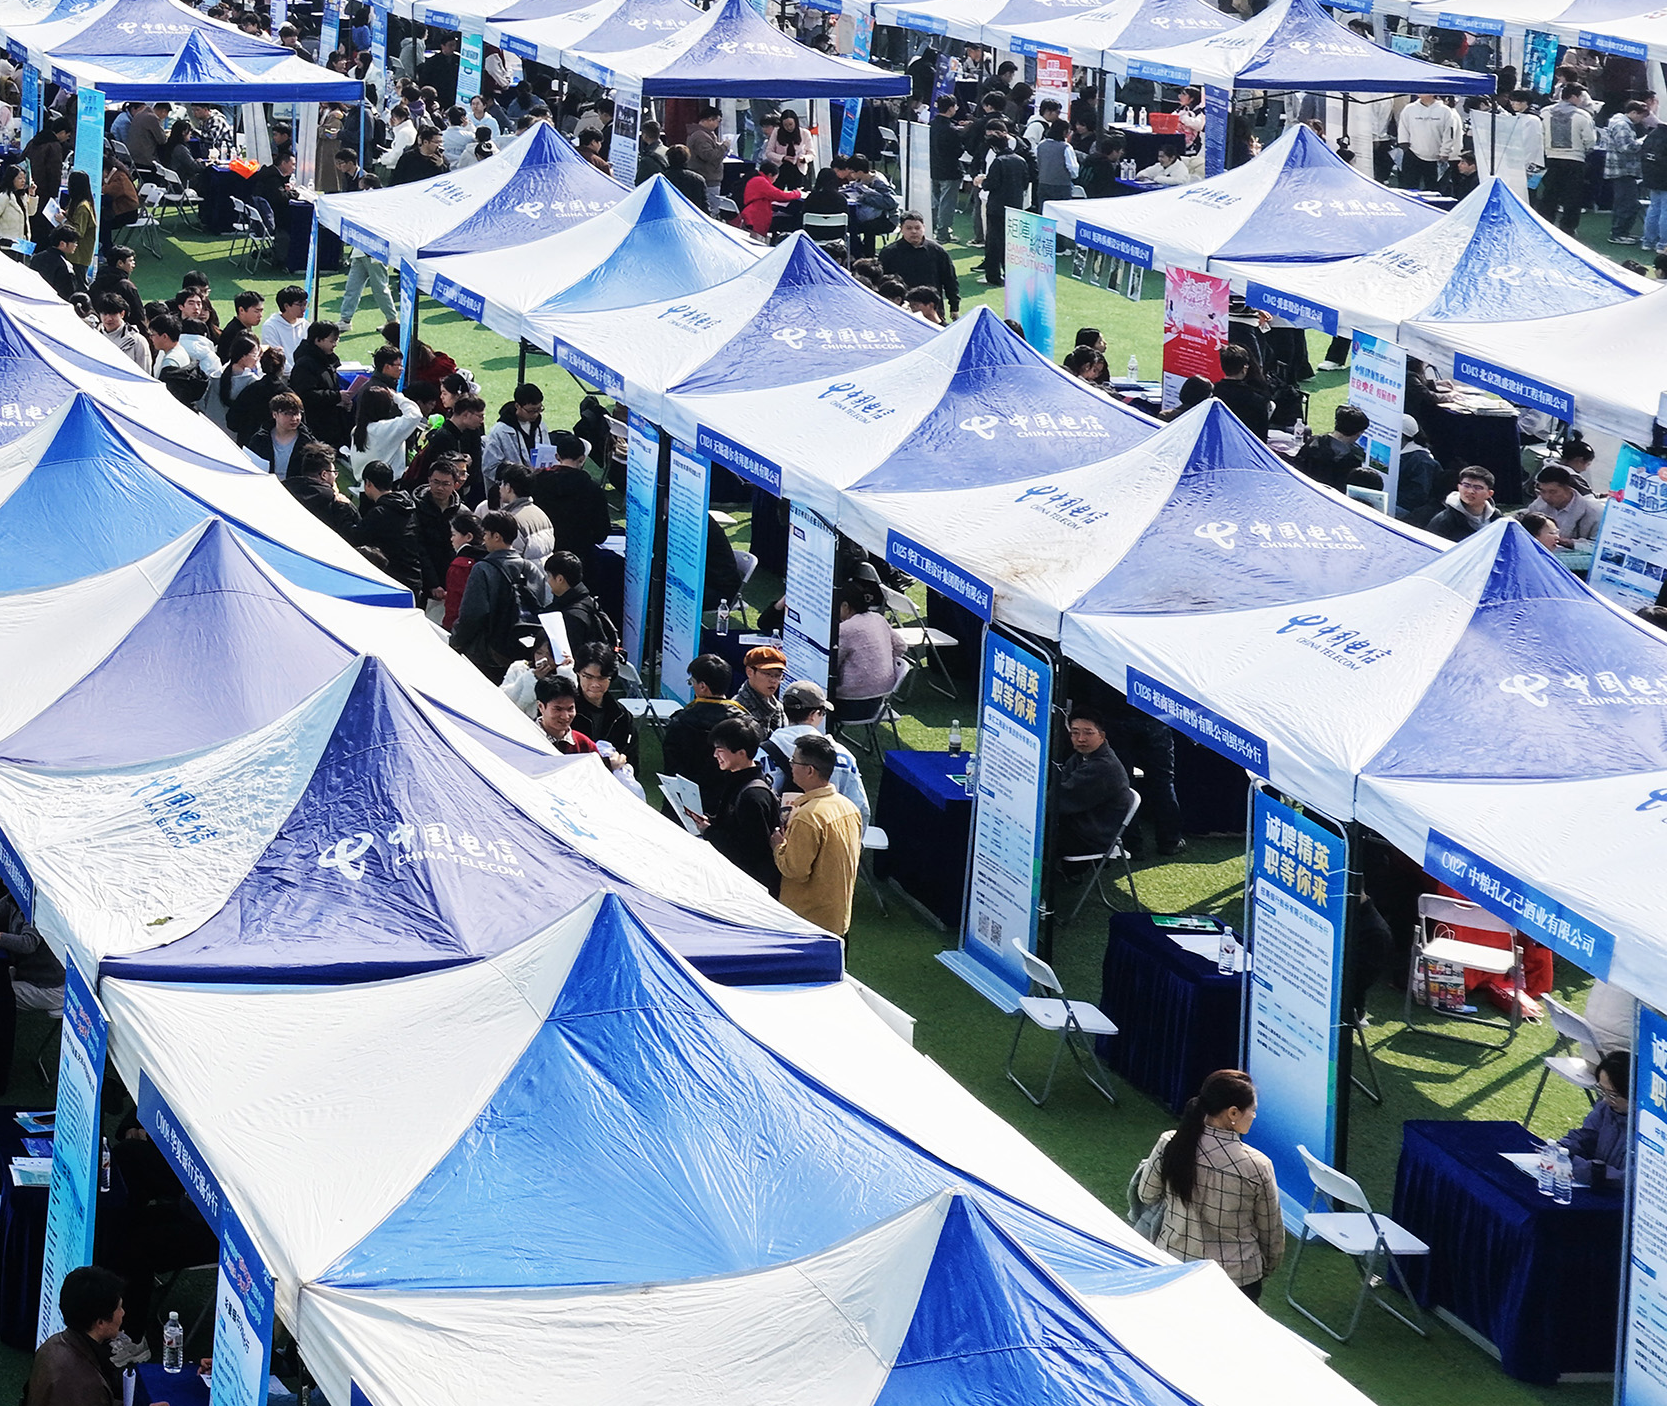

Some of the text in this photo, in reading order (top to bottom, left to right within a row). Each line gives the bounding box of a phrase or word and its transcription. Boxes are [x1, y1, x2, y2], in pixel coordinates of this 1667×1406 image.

[743, 42, 795, 55] 中国电信
[1329, 200, 1400, 214] 中国电信
[815, 326, 902, 343] 中国电信
[821, 341, 906, 350] CHINA TELECOM
[1461, 360, 1478, 379] C043
[1007, 413, 1105, 433] 中国电信
[1016, 428, 1110, 439] CHINA TELECOM
[1250, 521, 1359, 543] 中国电信
[1259, 539, 1366, 551] CHINA TELECOM
[892, 538, 988, 609] C025 华汇工程设计集团股份有限公司
[1317, 624, 1391, 667] 中国电信
[994, 647, 1039, 699] 诚聘精英
[990, 676, 1037, 726] 职等你来
[1578, 694, 1618, 705] CHINA
[1133, 678, 1261, 764] C026 招商银行股份有限公司绍兴分行
[389, 823, 520, 865] 中国电信
[1266, 811, 1330, 877] 诚聘精英
[395, 849, 526, 880] CHINA TELECOM
[1263, 843, 1328, 909] 职等你来
[1441, 849, 1595, 960] C027 中粮孔乙己酒业有限公司
[156, 1109, 219, 1218] C008 华夏银行无锡分行
